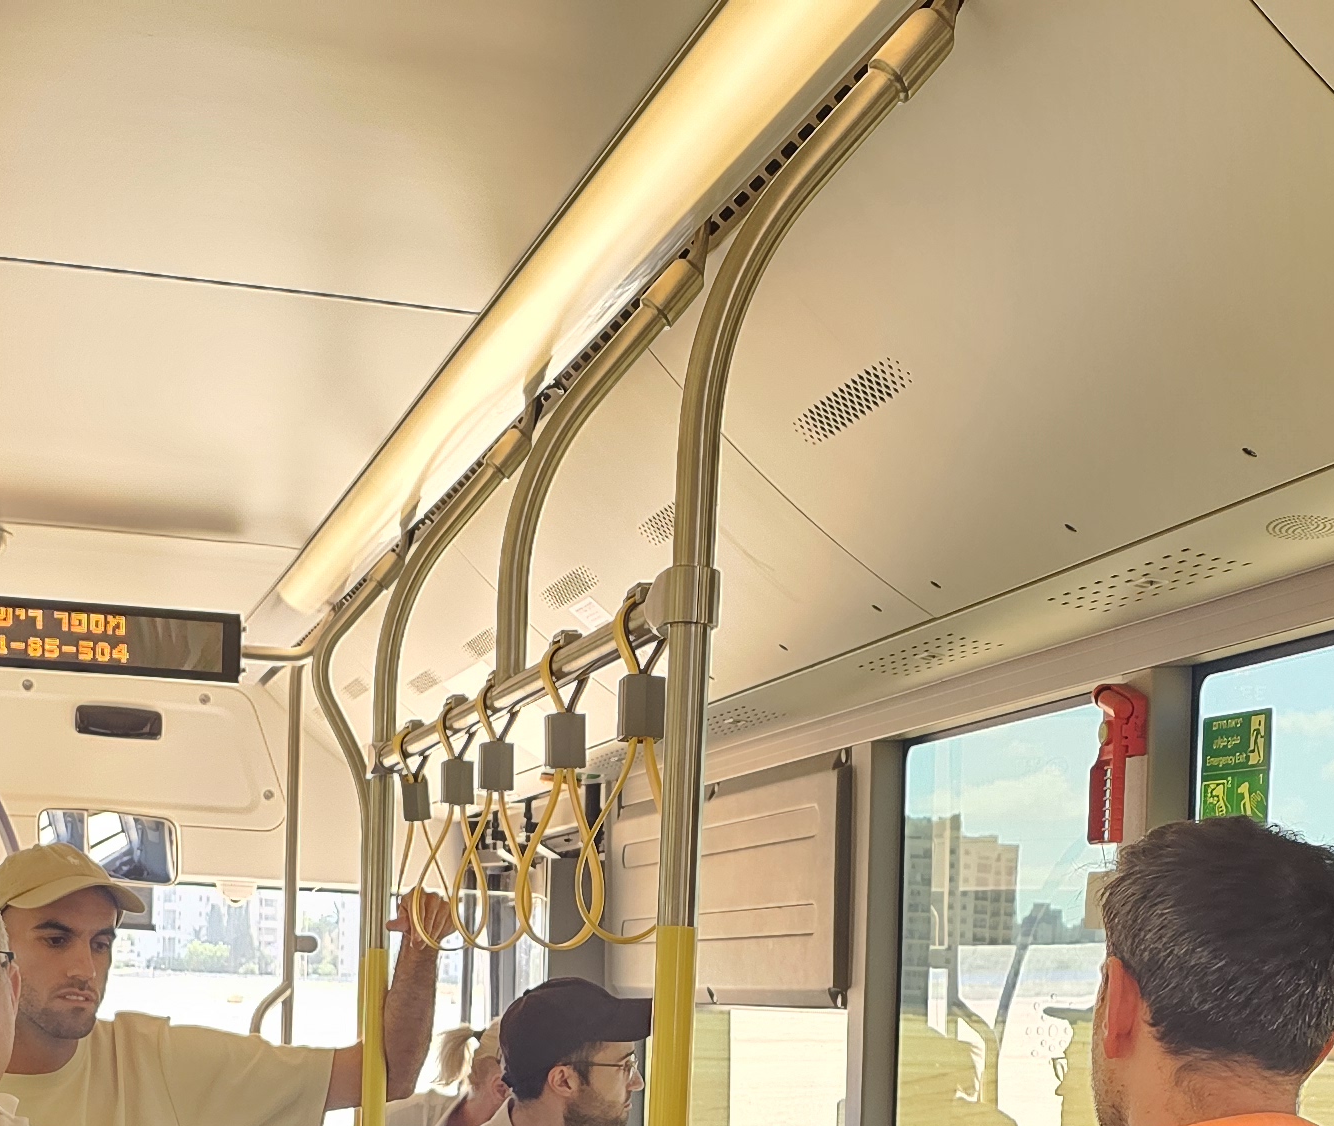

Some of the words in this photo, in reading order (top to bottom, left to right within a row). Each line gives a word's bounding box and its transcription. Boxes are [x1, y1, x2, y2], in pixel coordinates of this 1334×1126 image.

[53, 610, 126, 636] מספר
[1206, 755, 1236, 768] Emergency
[1235, 751, 1247, 763] Exit
[1227, 776, 1232, 788] 2
[1259, 773, 1264, 785] 1
